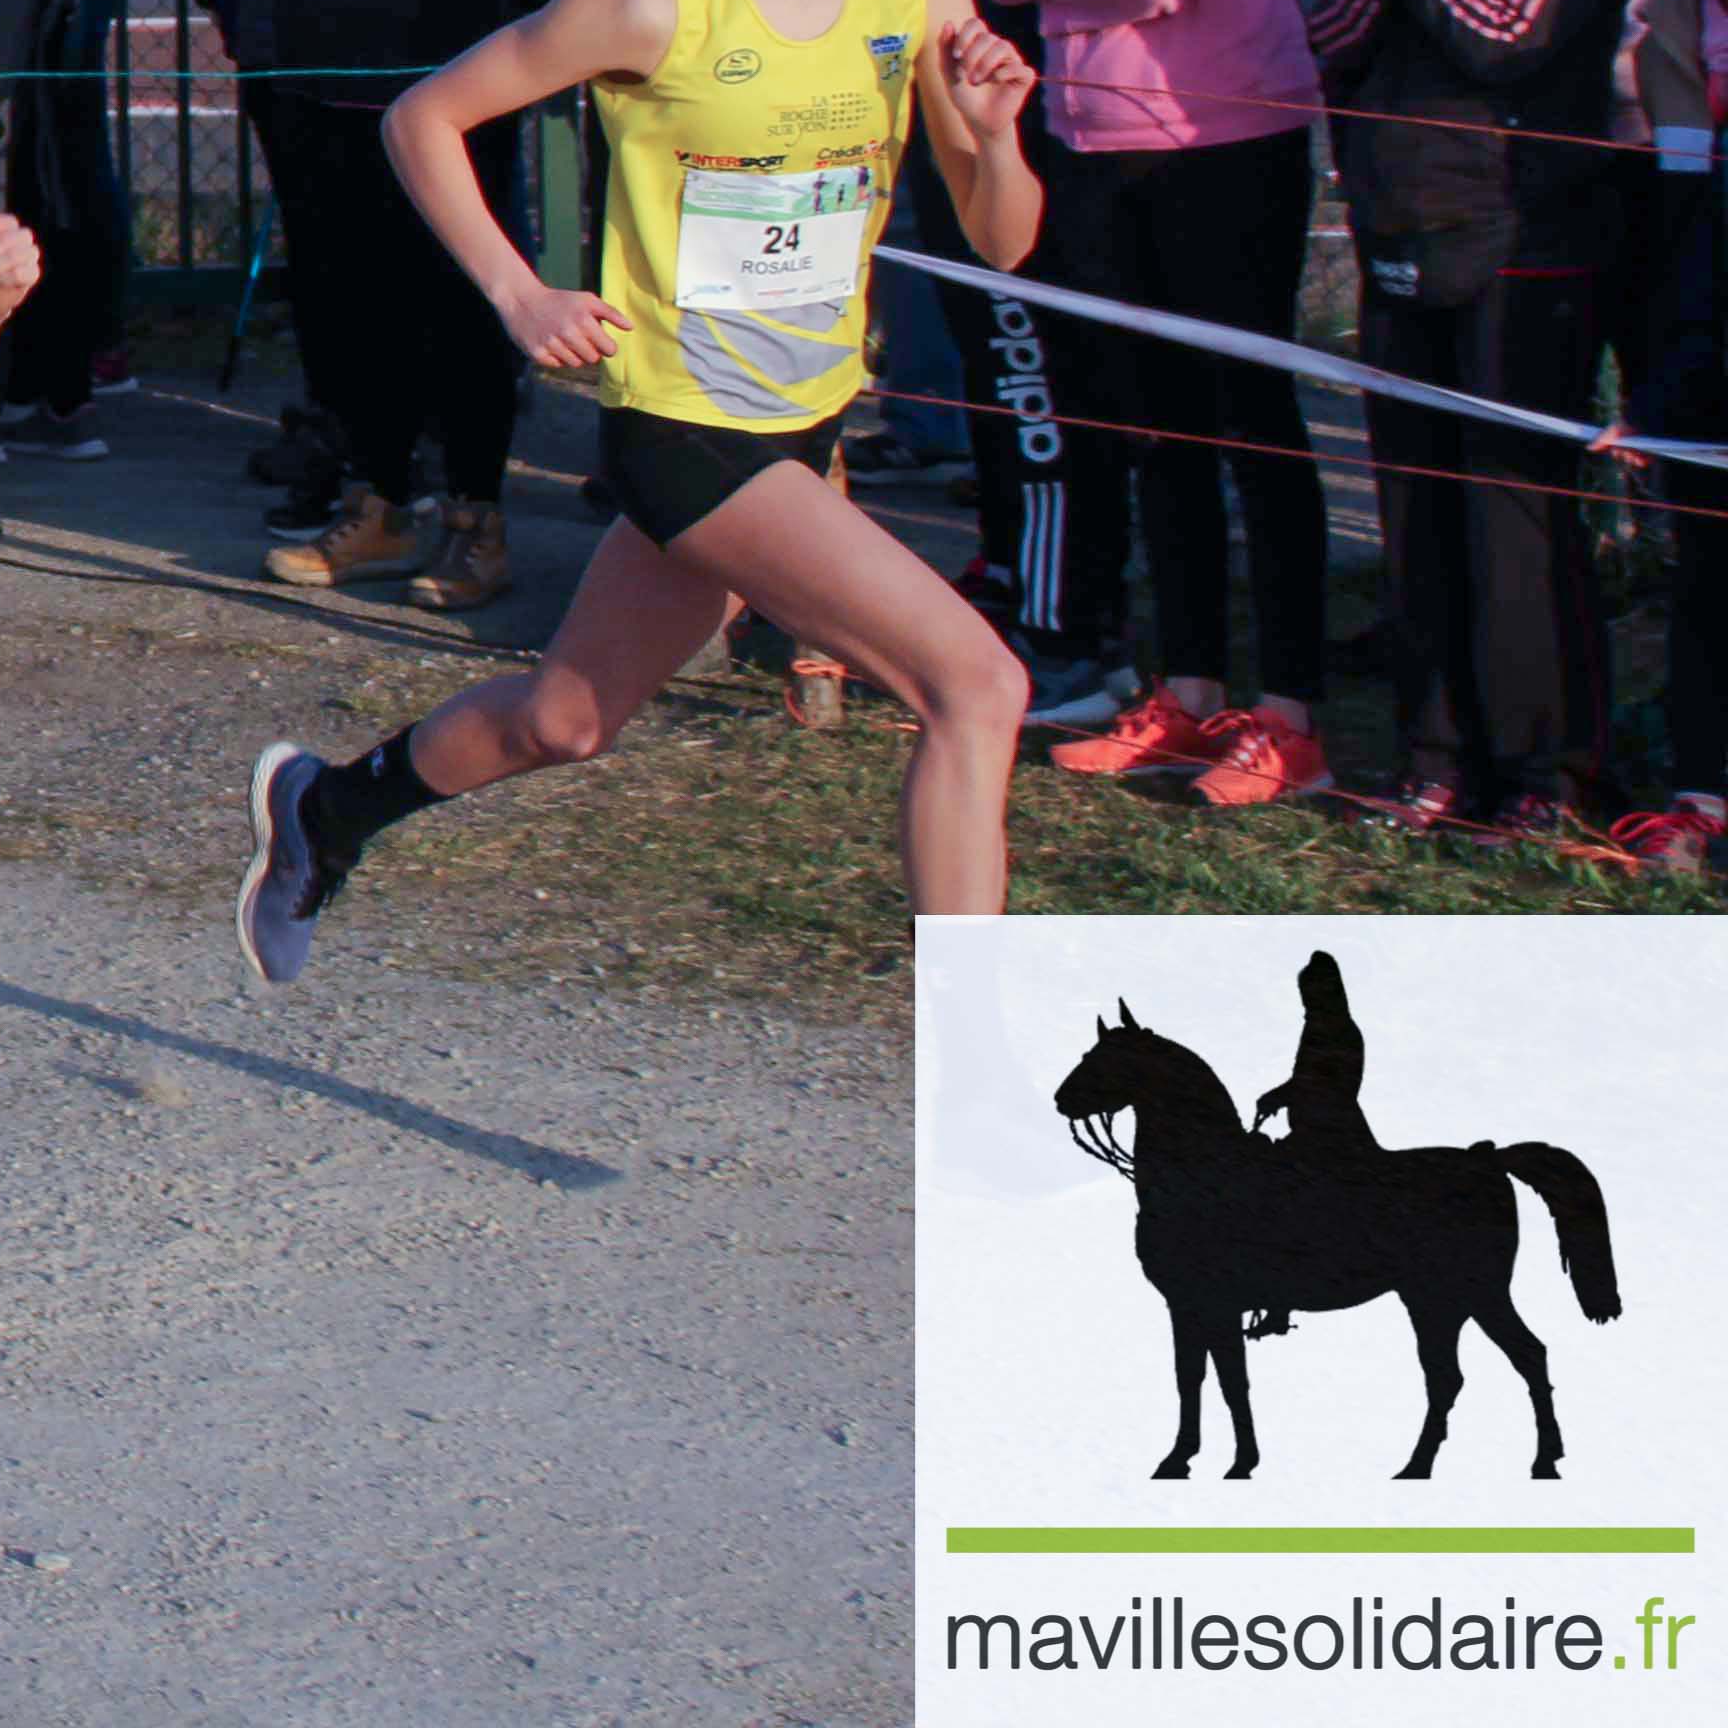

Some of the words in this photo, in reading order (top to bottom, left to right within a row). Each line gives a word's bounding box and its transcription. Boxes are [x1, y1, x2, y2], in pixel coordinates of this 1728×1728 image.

[779, 108, 829, 123] ROCHE
[692, 154, 788, 169] INTERSPORT
[762, 223, 801, 255] 24
[740, 255, 814, 276] ROSALIE
